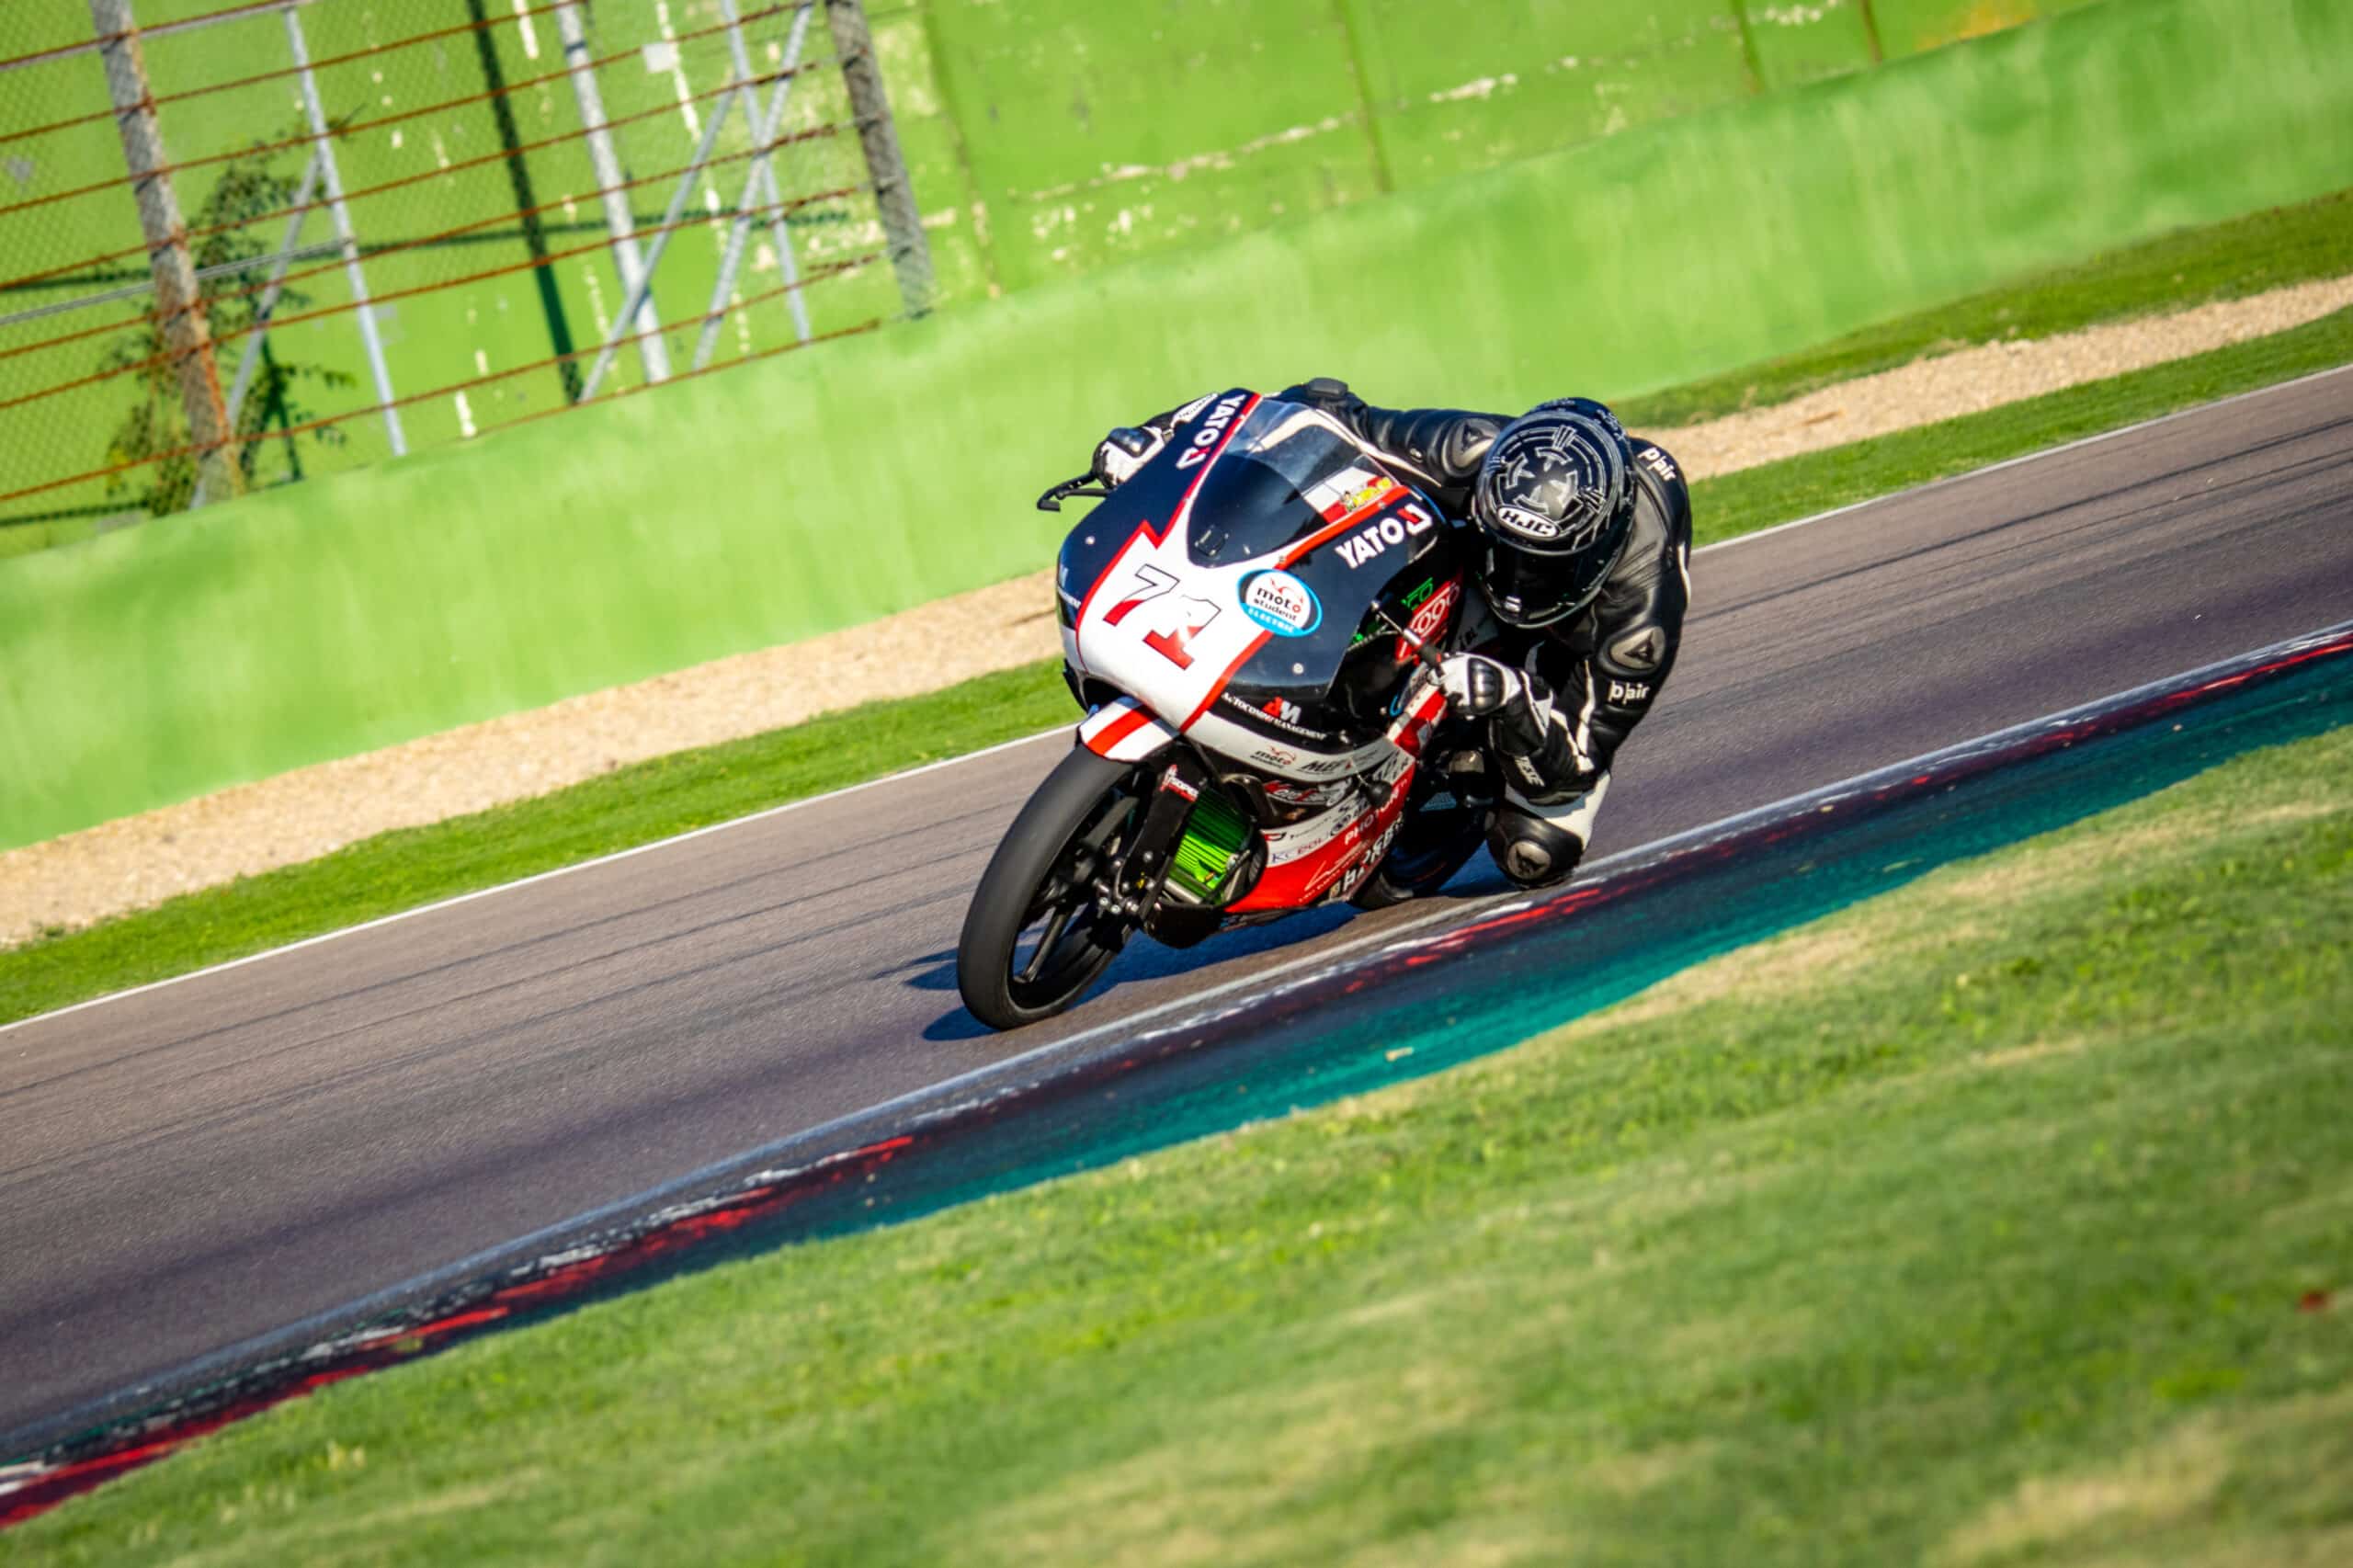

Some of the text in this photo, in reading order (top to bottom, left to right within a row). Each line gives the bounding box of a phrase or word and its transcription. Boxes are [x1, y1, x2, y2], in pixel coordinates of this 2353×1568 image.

[1194, 393, 1246, 448] YATO
[1502, 510, 1554, 536] HJC
[1335, 517, 1404, 570] YATO
[1253, 597, 1298, 622] student
[1256, 586, 1302, 614] moto
